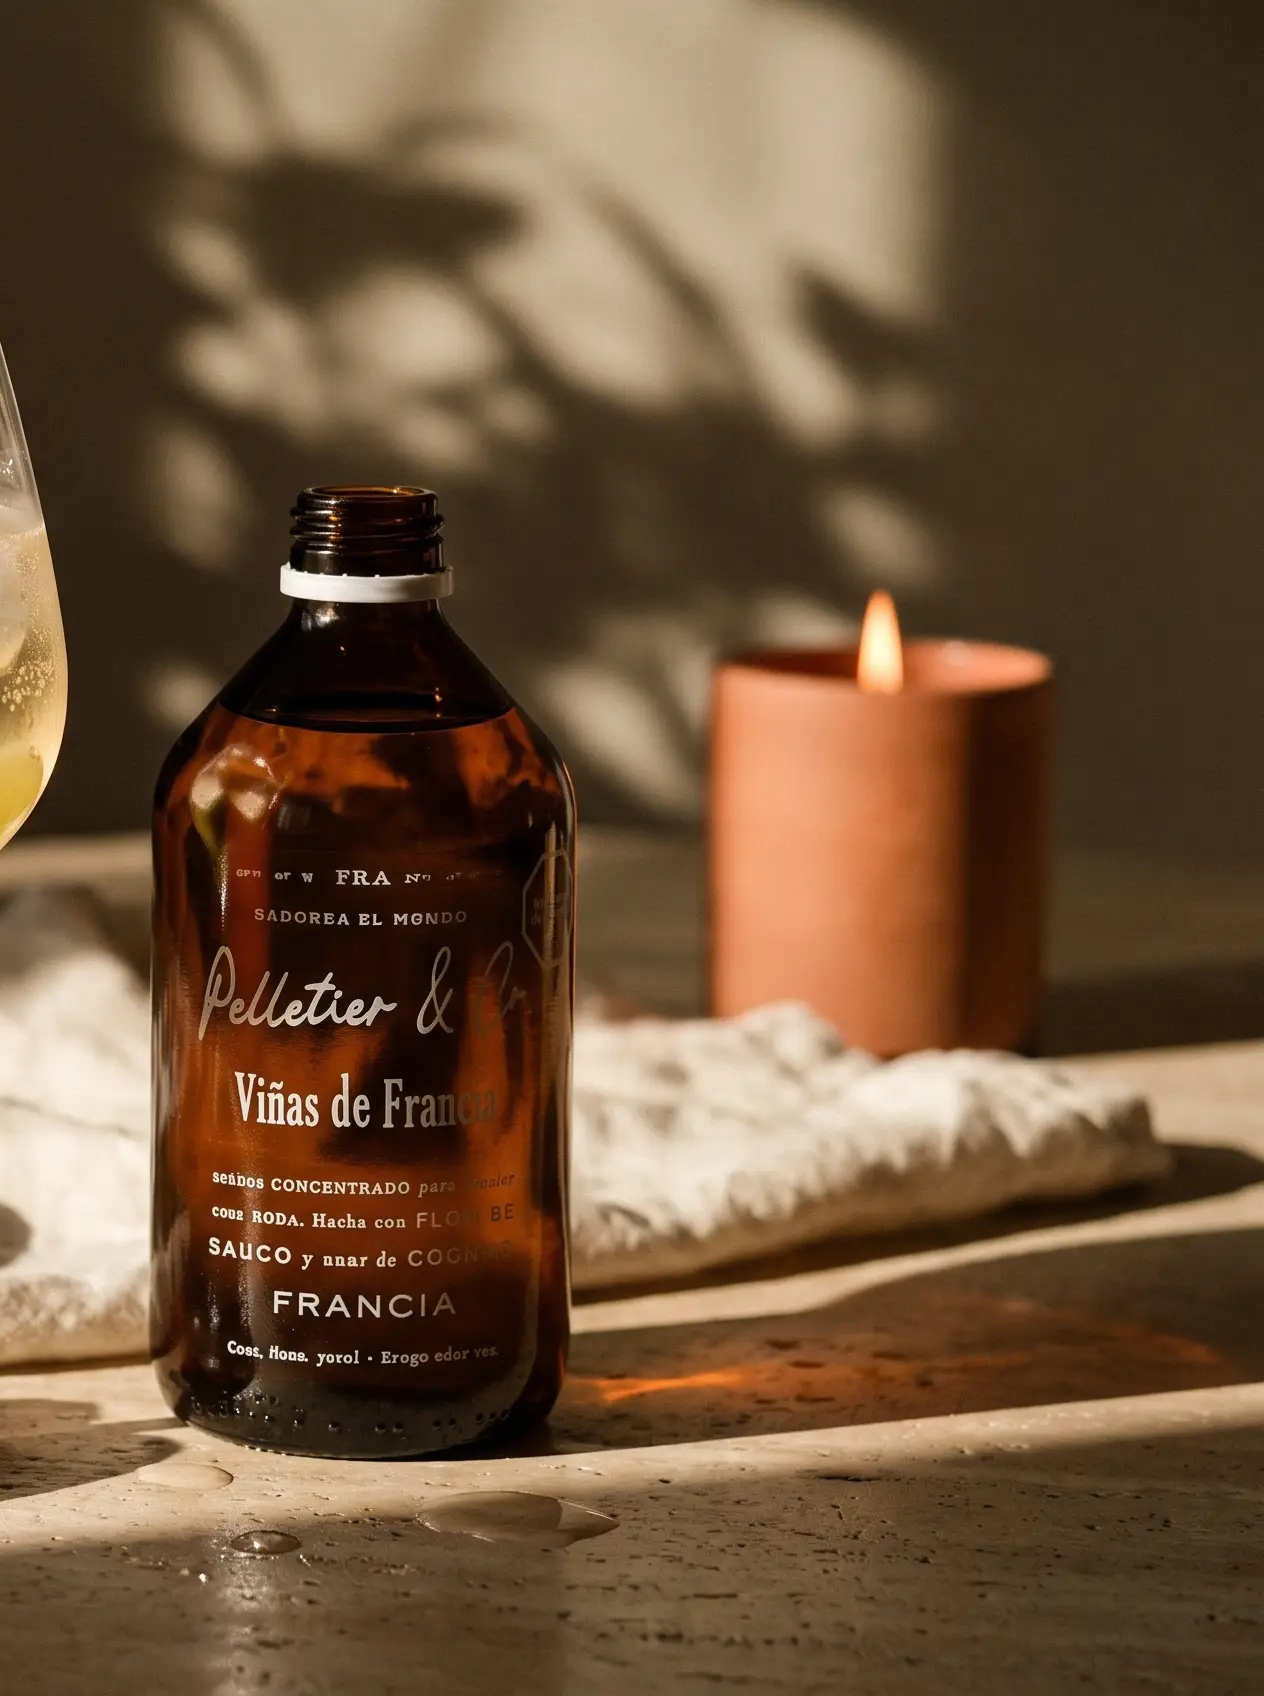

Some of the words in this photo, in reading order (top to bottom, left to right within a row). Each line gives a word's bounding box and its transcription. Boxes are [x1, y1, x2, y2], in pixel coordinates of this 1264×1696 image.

[335, 869, 392, 886] FRA
[254, 908, 350, 925] SADOREA
[358, 913, 383, 926] EL
[198, 945, 398, 1041] Pelletier
[416, 945, 455, 1035] &
[234, 1070, 320, 1128] Viñas
[331, 1072, 371, 1129] de
[382, 1077, 497, 1129] Francia
[270, 1177, 411, 1195] CONCENTRADO
[251, 1210, 305, 1227] RODA.
[311, 1212, 367, 1229] Hacha
[374, 1217, 406, 1229] con
[416, 1209, 479, 1229] FLO
[490, 1203, 515, 1222] BE
[208, 1236, 292, 1265] SAUCO
[301, 1253, 314, 1271] y
[376, 1250, 397, 1268] de
[272, 1290, 457, 1319] FRANCIA
